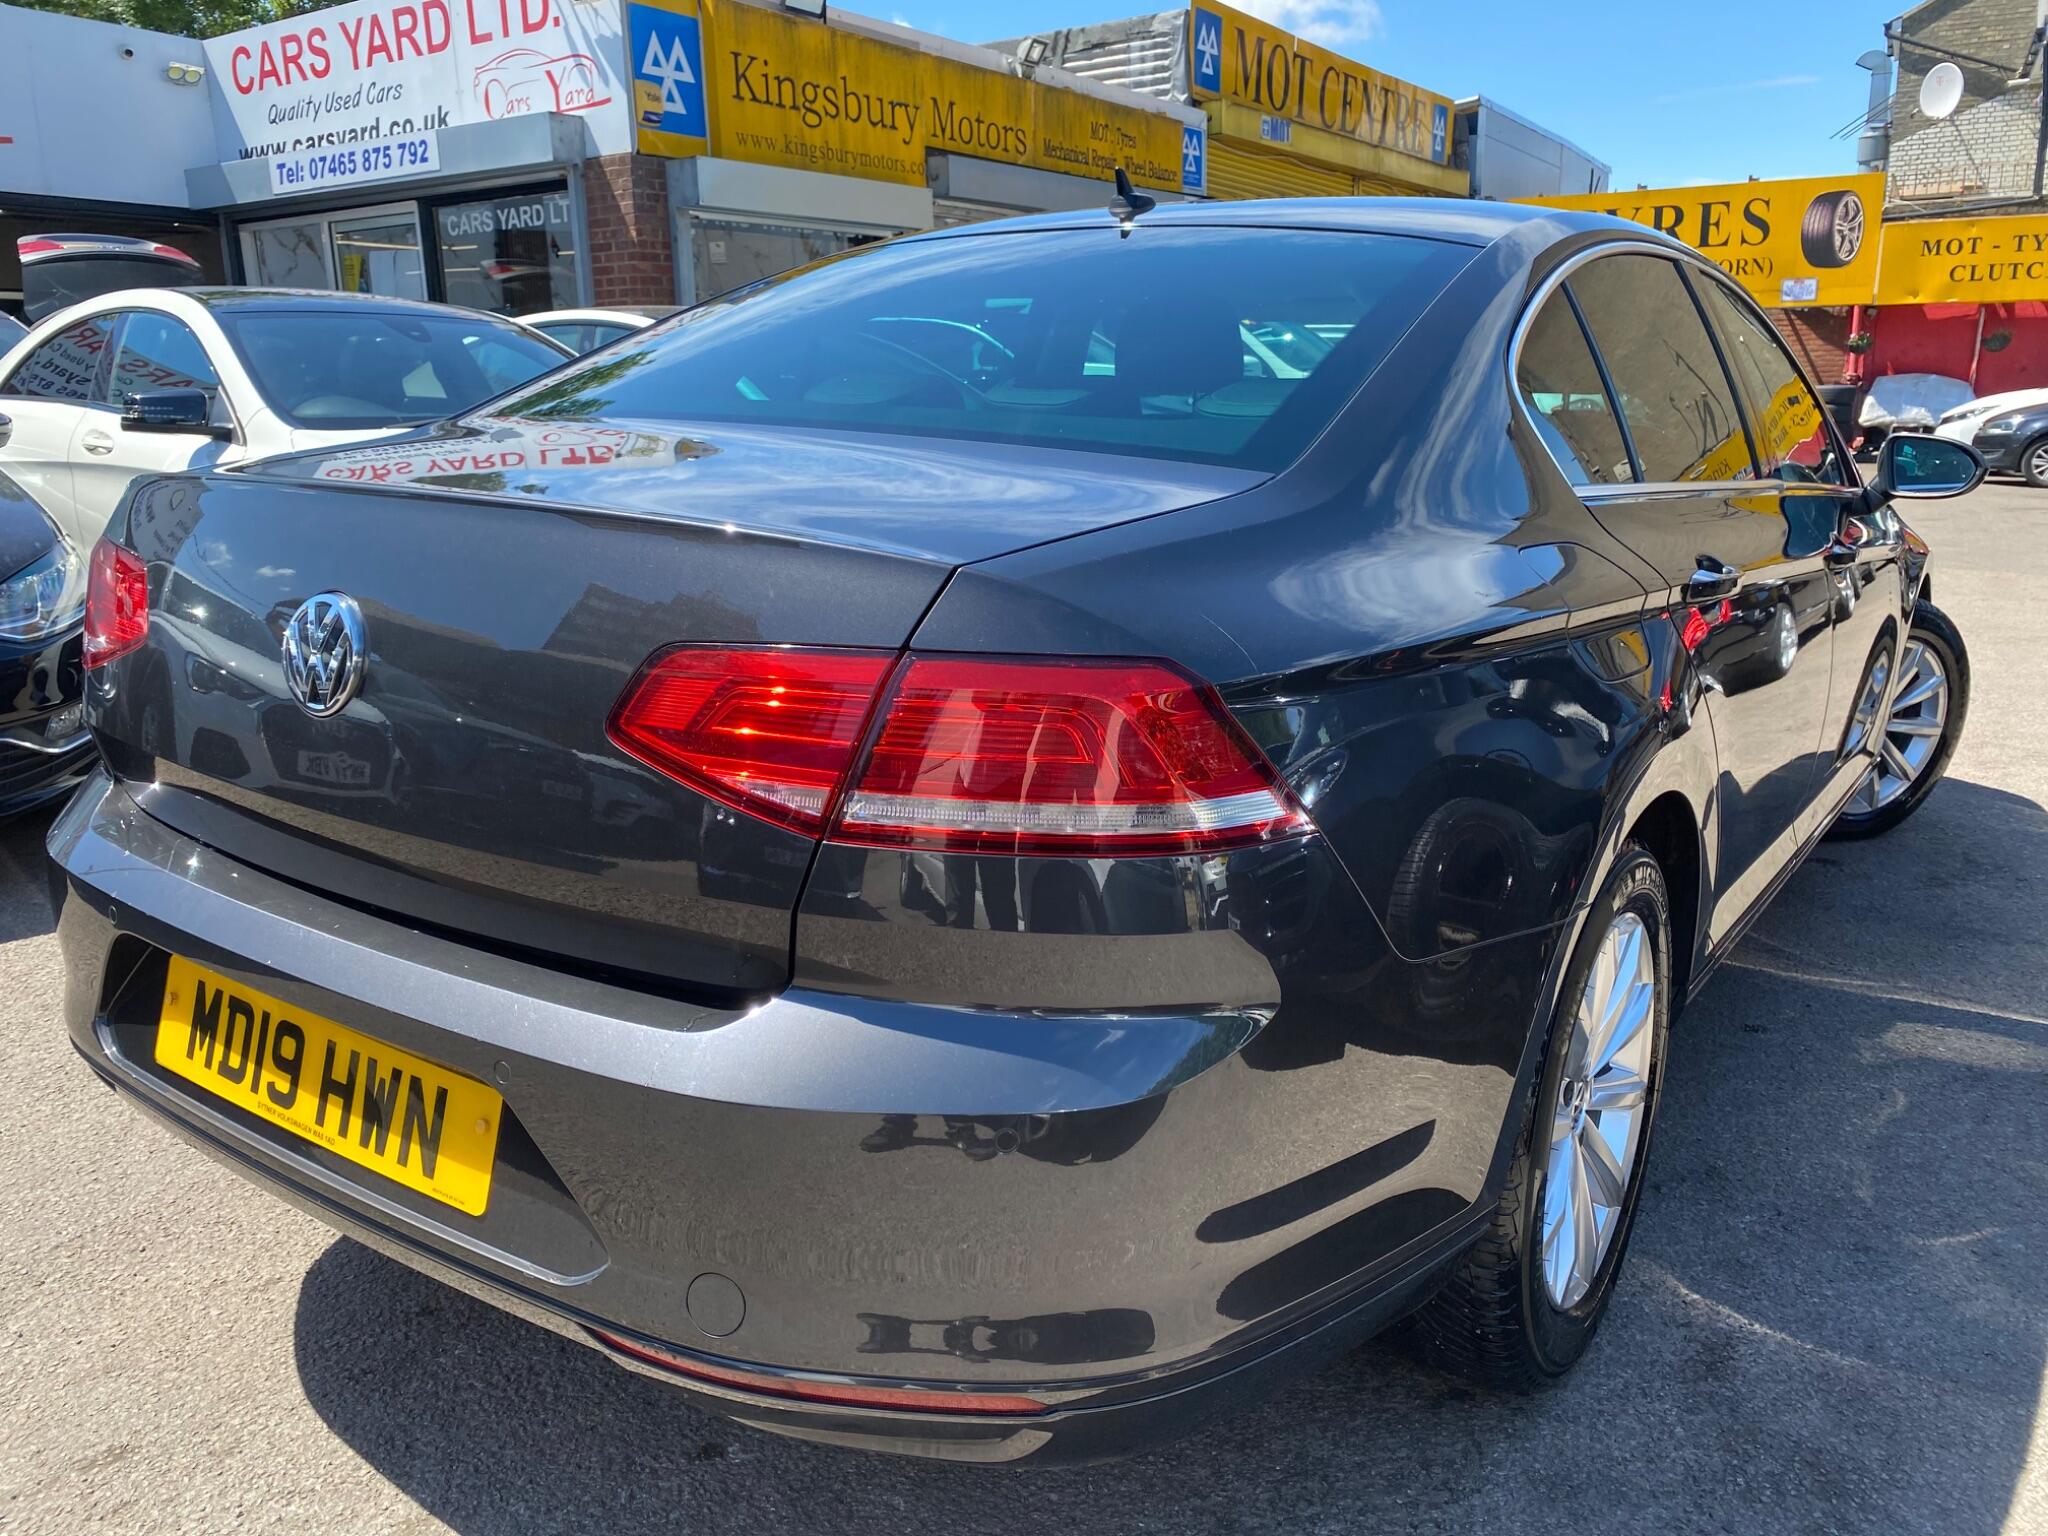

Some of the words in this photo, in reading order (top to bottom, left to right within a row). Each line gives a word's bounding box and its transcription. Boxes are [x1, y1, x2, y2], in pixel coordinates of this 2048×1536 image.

[231, 26, 331, 95] CARS
[338, 0, 451, 71] YARD
[467, 0, 560, 45] LTD.
[268, 95, 321, 123] Quality
[325, 91, 361, 114] Used
[367, 81, 403, 105] Cars
[484, 79, 531, 119] Cars
[545, 64, 601, 112] Yard
[730, 51, 920, 145] Kingsbury
[931, 97, 1028, 157] Motors
[1232, 26, 1312, 120] MOT
[1319, 65, 1425, 154] CENTRE
[1090, 121, 1109, 143] MOT
[1116, 126, 1137, 151] Tyres
[276, 160, 304, 185] Tel:
[309, 152, 356, 180] 07465
[362, 145, 392, 172] 875
[397, 139, 429, 166] 792
[1043, 138, 1090, 165] Mechanical
[1148, 161, 1177, 182] Balance
[447, 210, 493, 236] CARS
[497, 204, 544, 230] YARD
[1604, 198, 1770, 249] RES
[1920, 236, 1983, 257] MOT
[1949, 261, 2048, 282] CLUTC
[186, 979, 305, 1110] MD19
[315, 1038, 449, 1181] HWN
